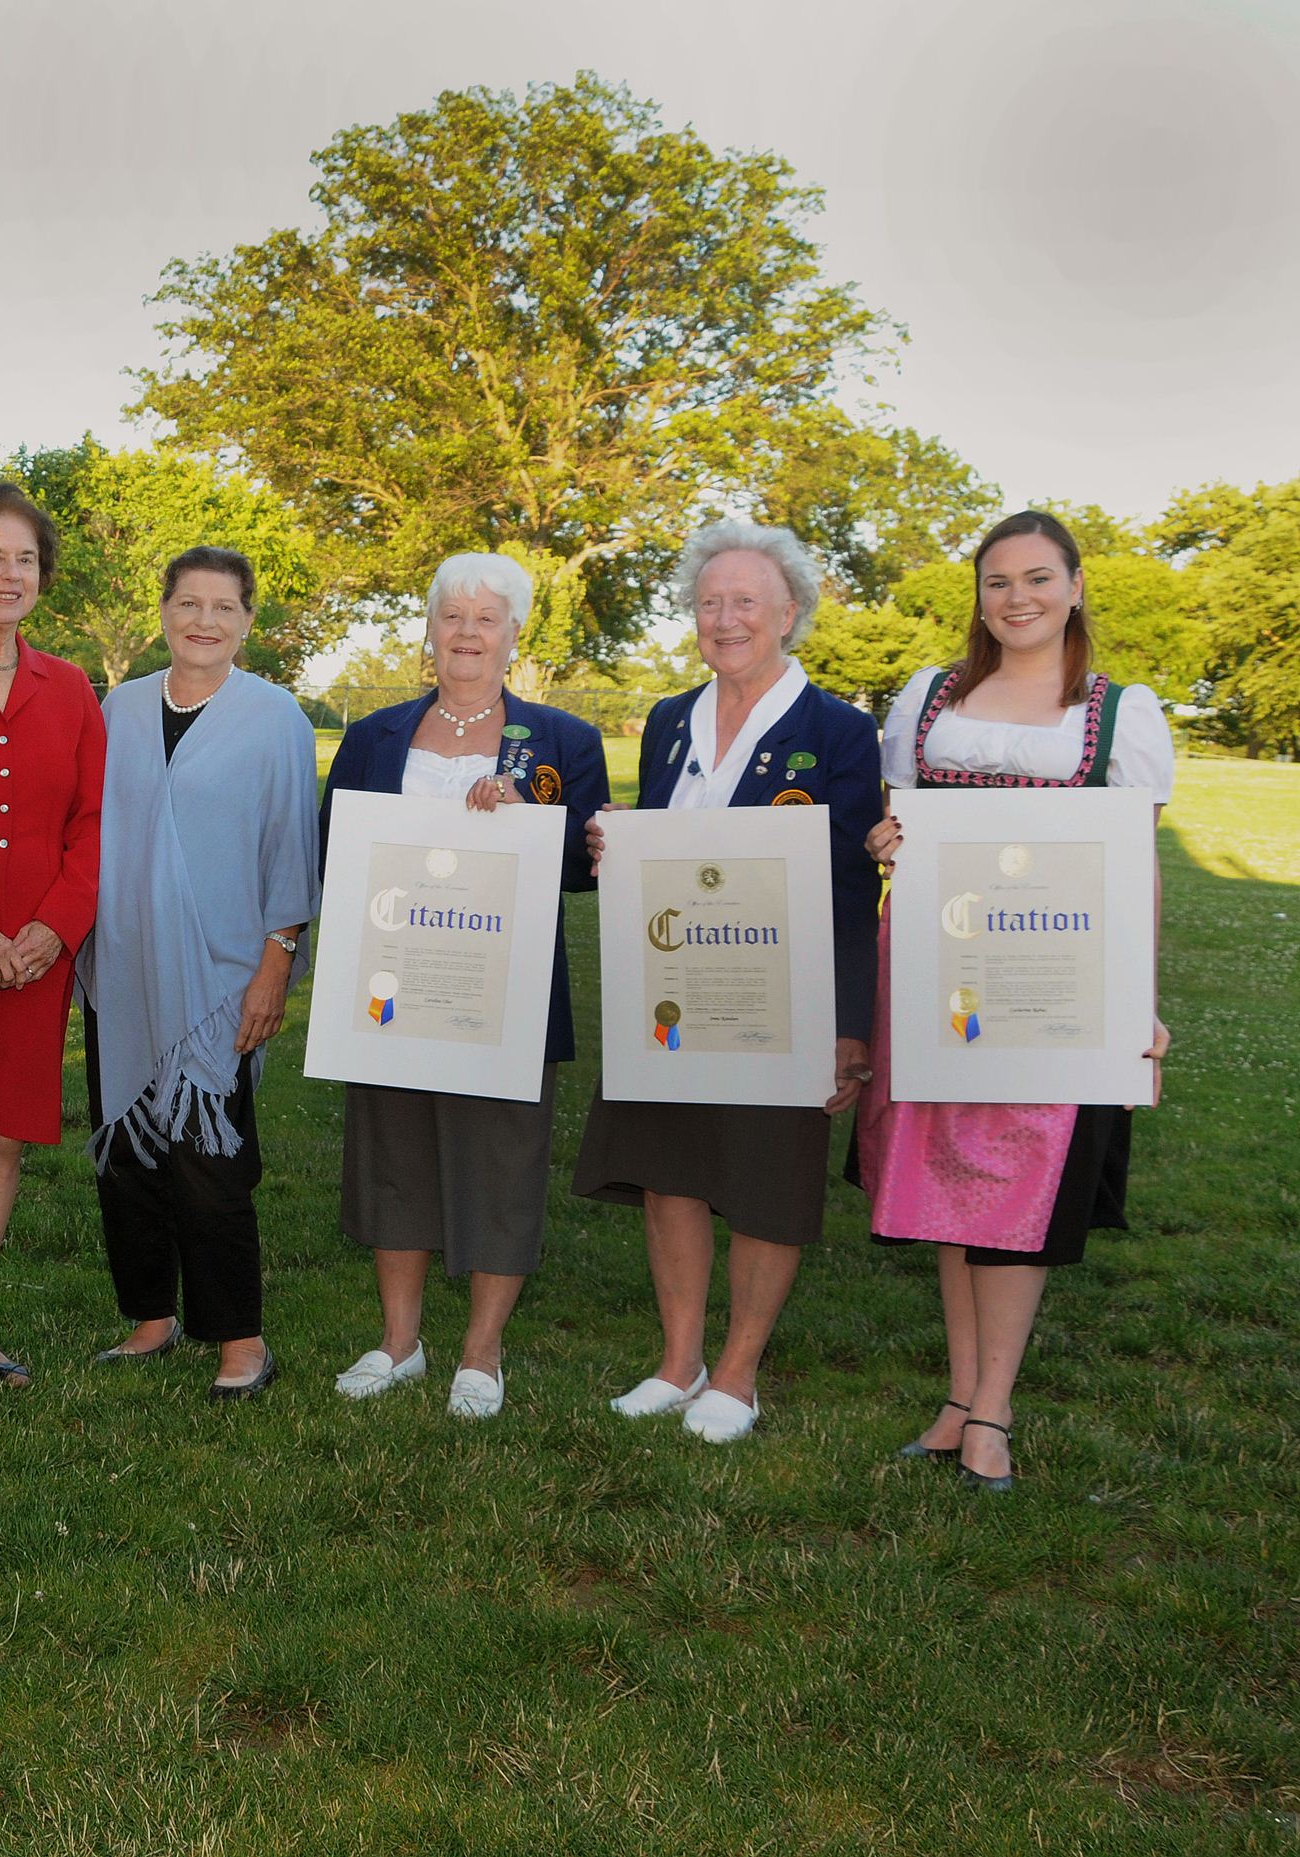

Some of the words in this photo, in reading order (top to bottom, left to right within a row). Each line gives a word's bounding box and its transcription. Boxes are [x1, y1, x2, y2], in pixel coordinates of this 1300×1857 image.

[370, 886, 503, 934] Citation
[647, 908, 780, 952] Citation
[941, 891, 1092, 940] Citation
